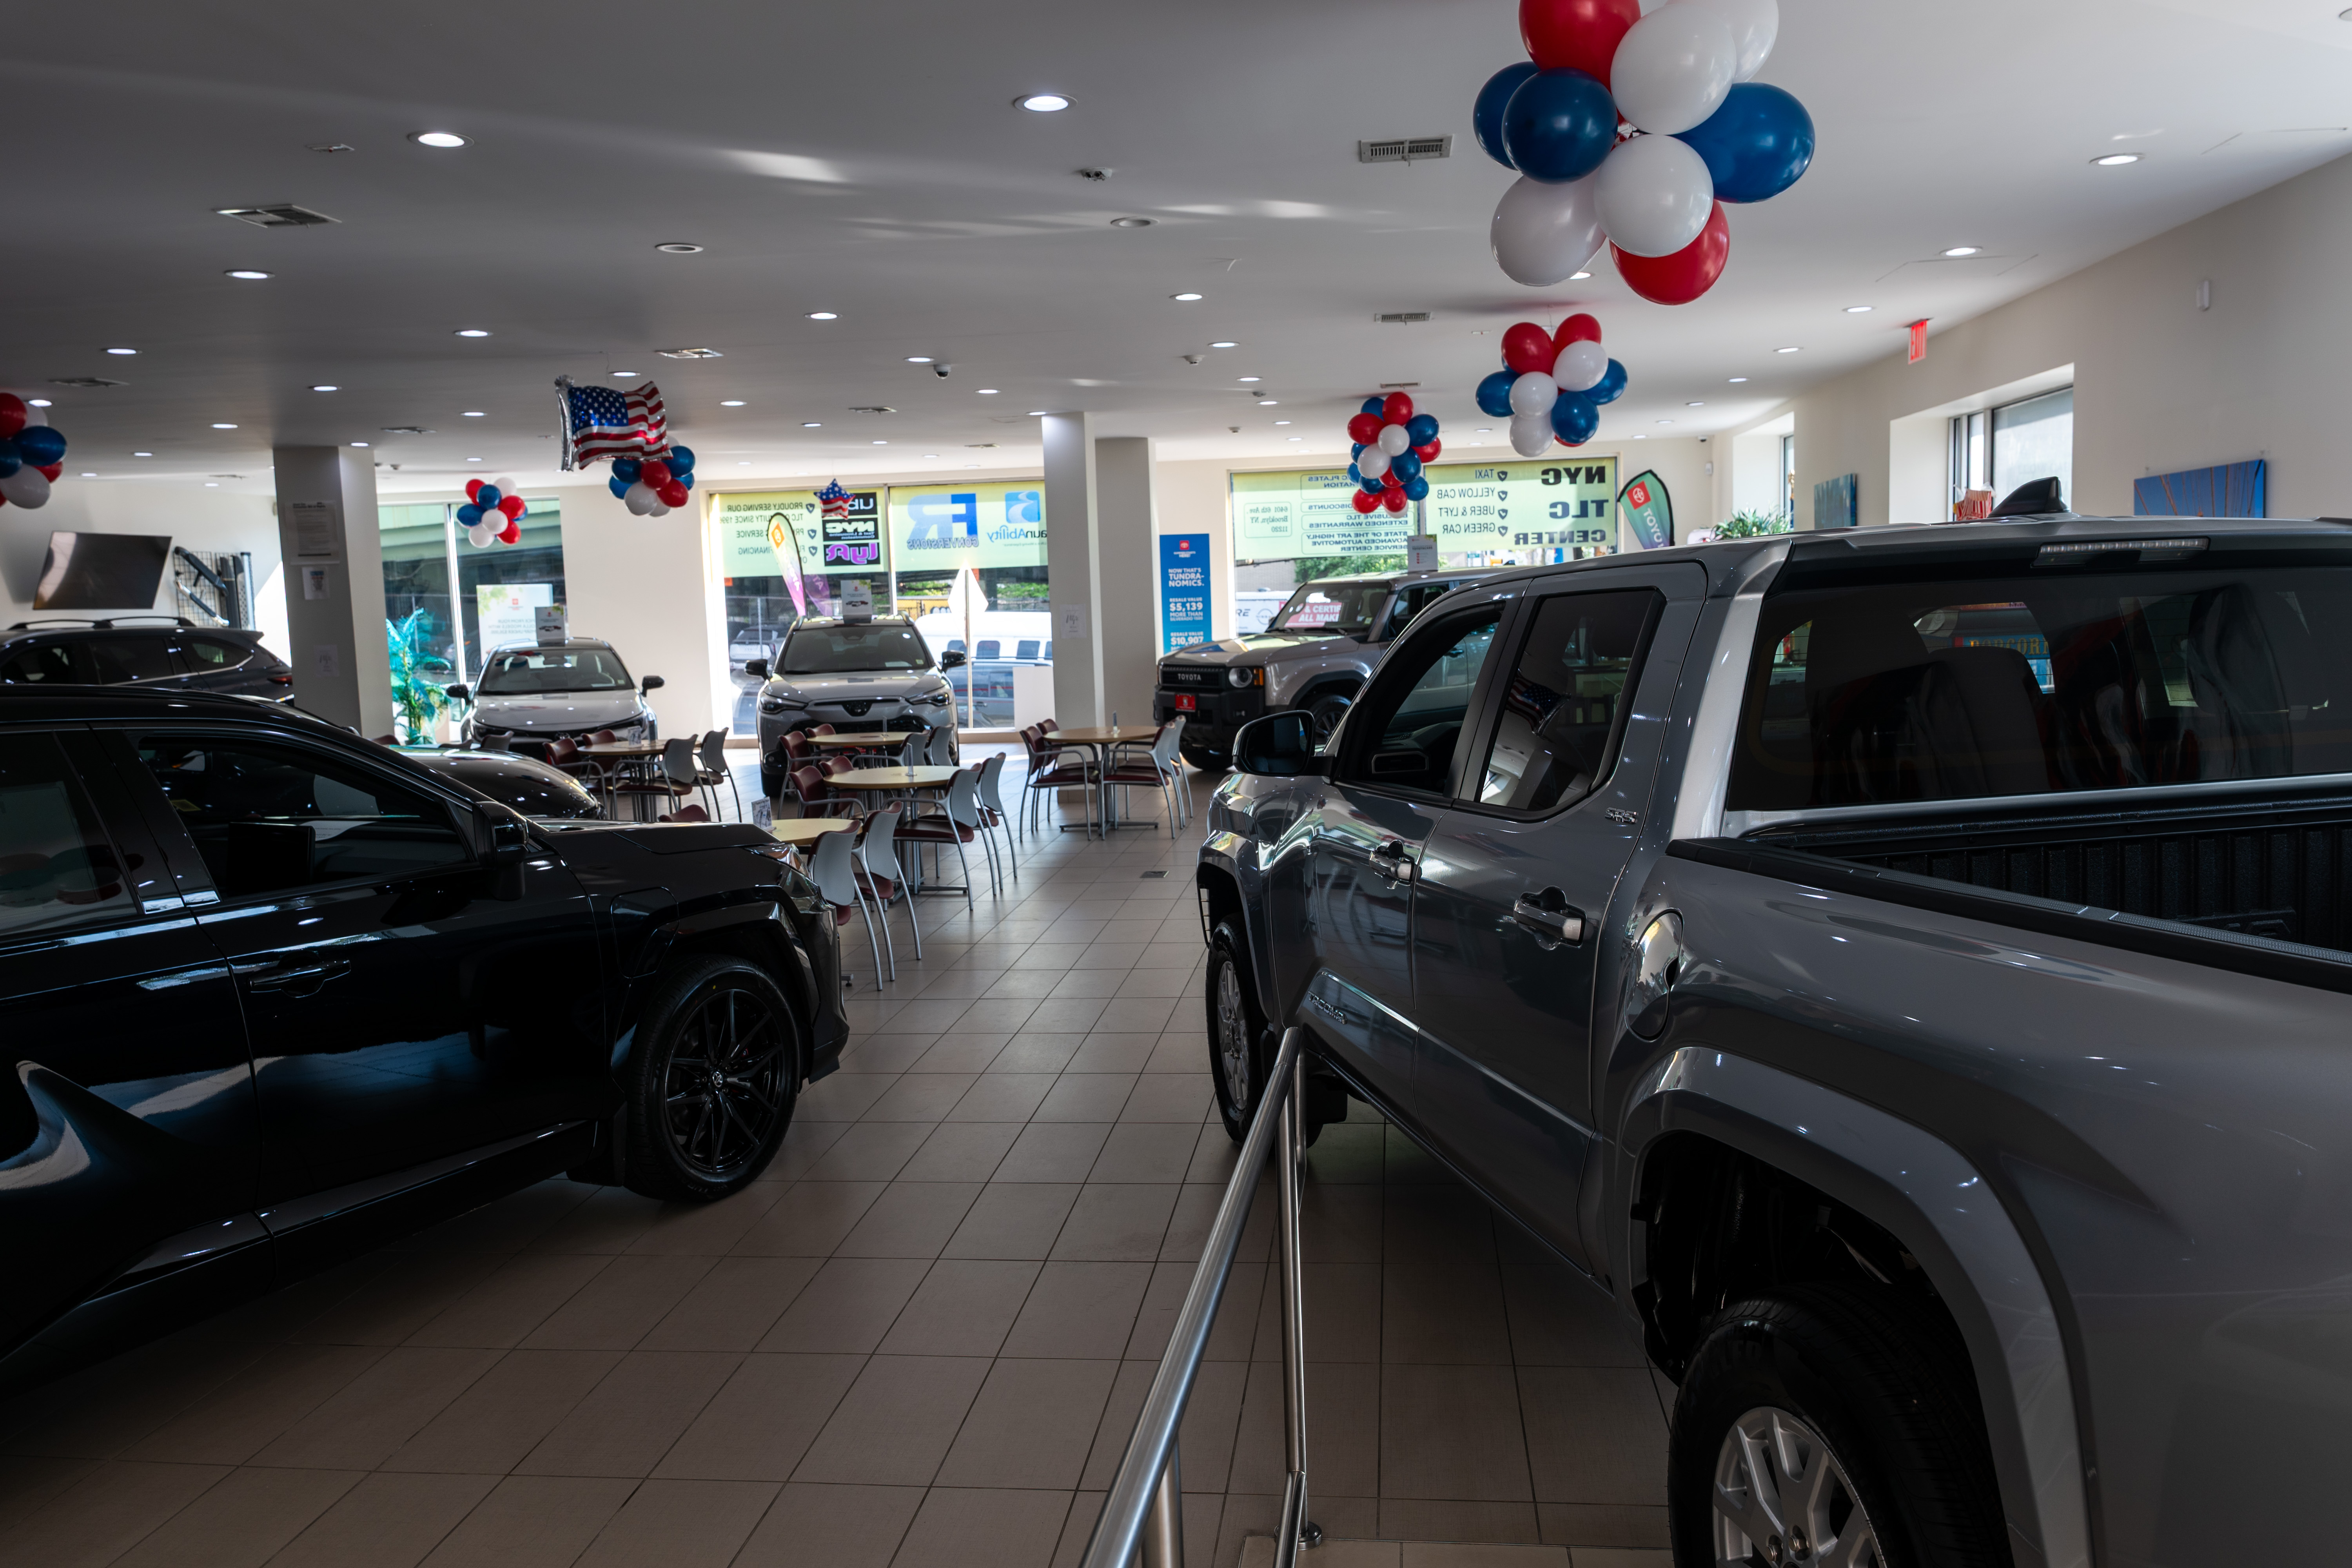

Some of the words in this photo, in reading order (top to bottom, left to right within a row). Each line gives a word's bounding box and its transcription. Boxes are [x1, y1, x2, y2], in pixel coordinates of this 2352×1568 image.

[1643, 508, 1664, 548] TOYO
[1170, 603, 1203, 612] $5,139
[1312, 603, 1342, 613] CERTIF
[1299, 614, 1314, 622] ALL
[1171, 636, 1204, 646] $10,907
[1604, 807, 1639, 824] SR5
[1308, 991, 1348, 1025] TACOMA
